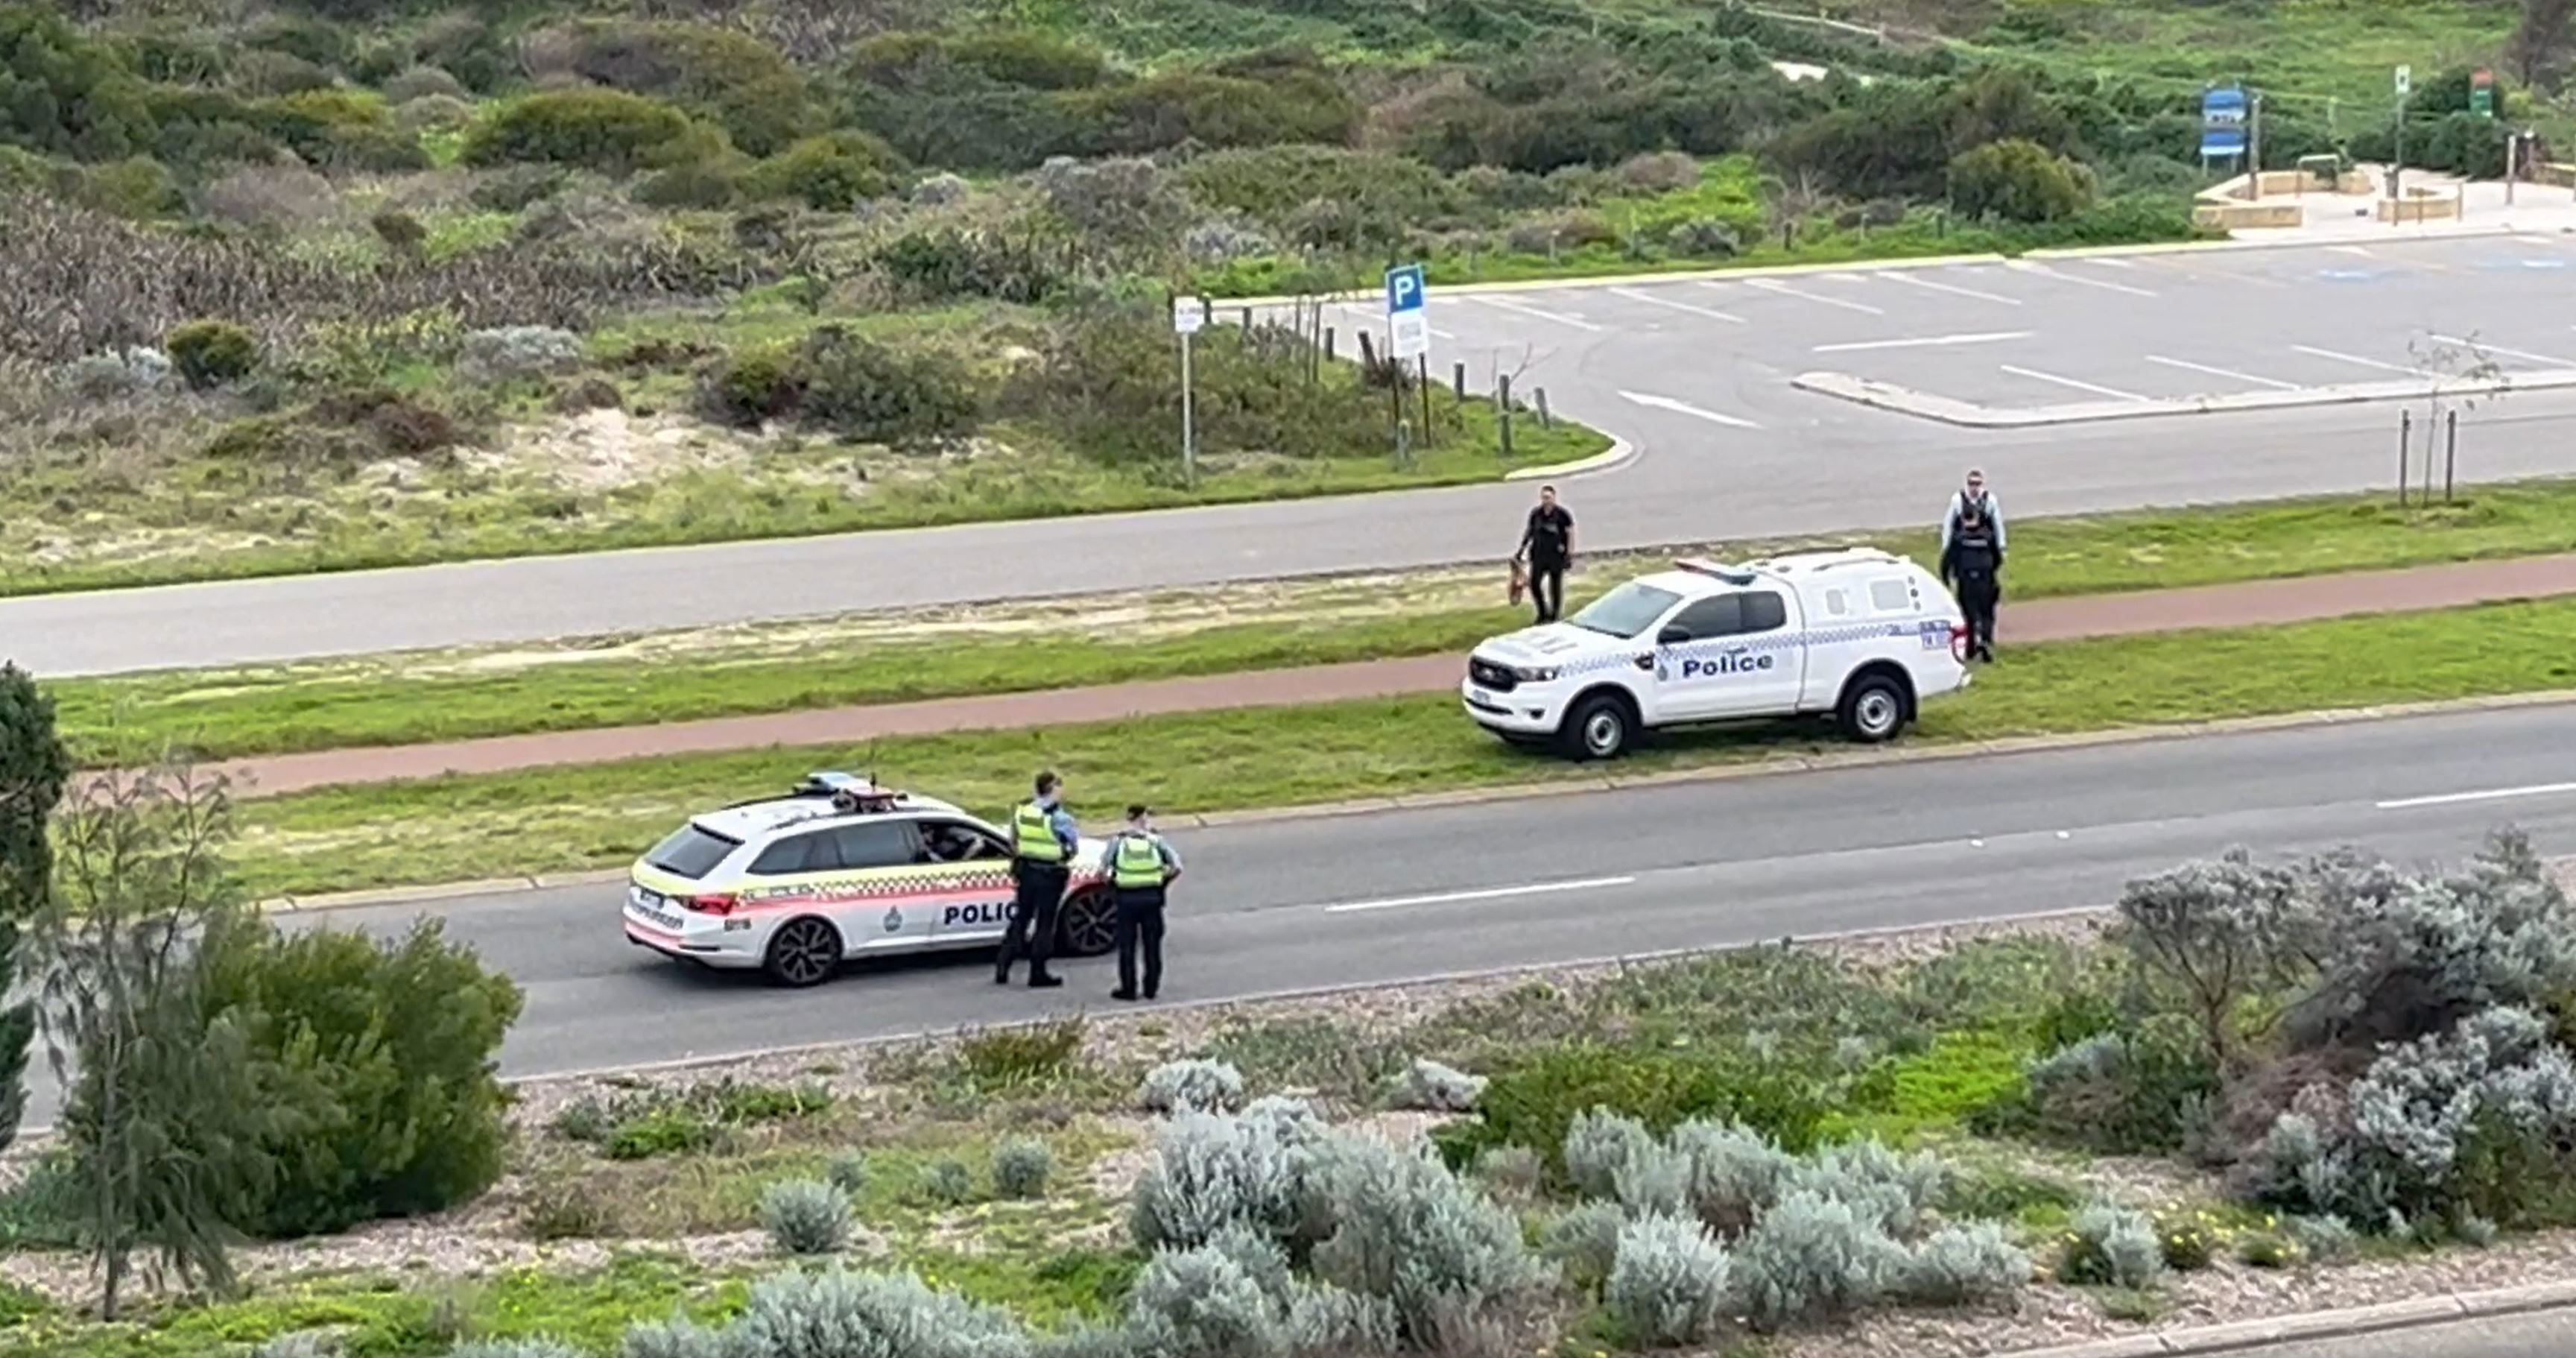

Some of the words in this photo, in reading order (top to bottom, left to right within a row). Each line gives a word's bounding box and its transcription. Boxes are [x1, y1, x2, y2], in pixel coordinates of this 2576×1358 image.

[1395, 276, 1414, 306] P
[1683, 654, 1773, 678] Police
[944, 901, 1019, 925] POLIC
